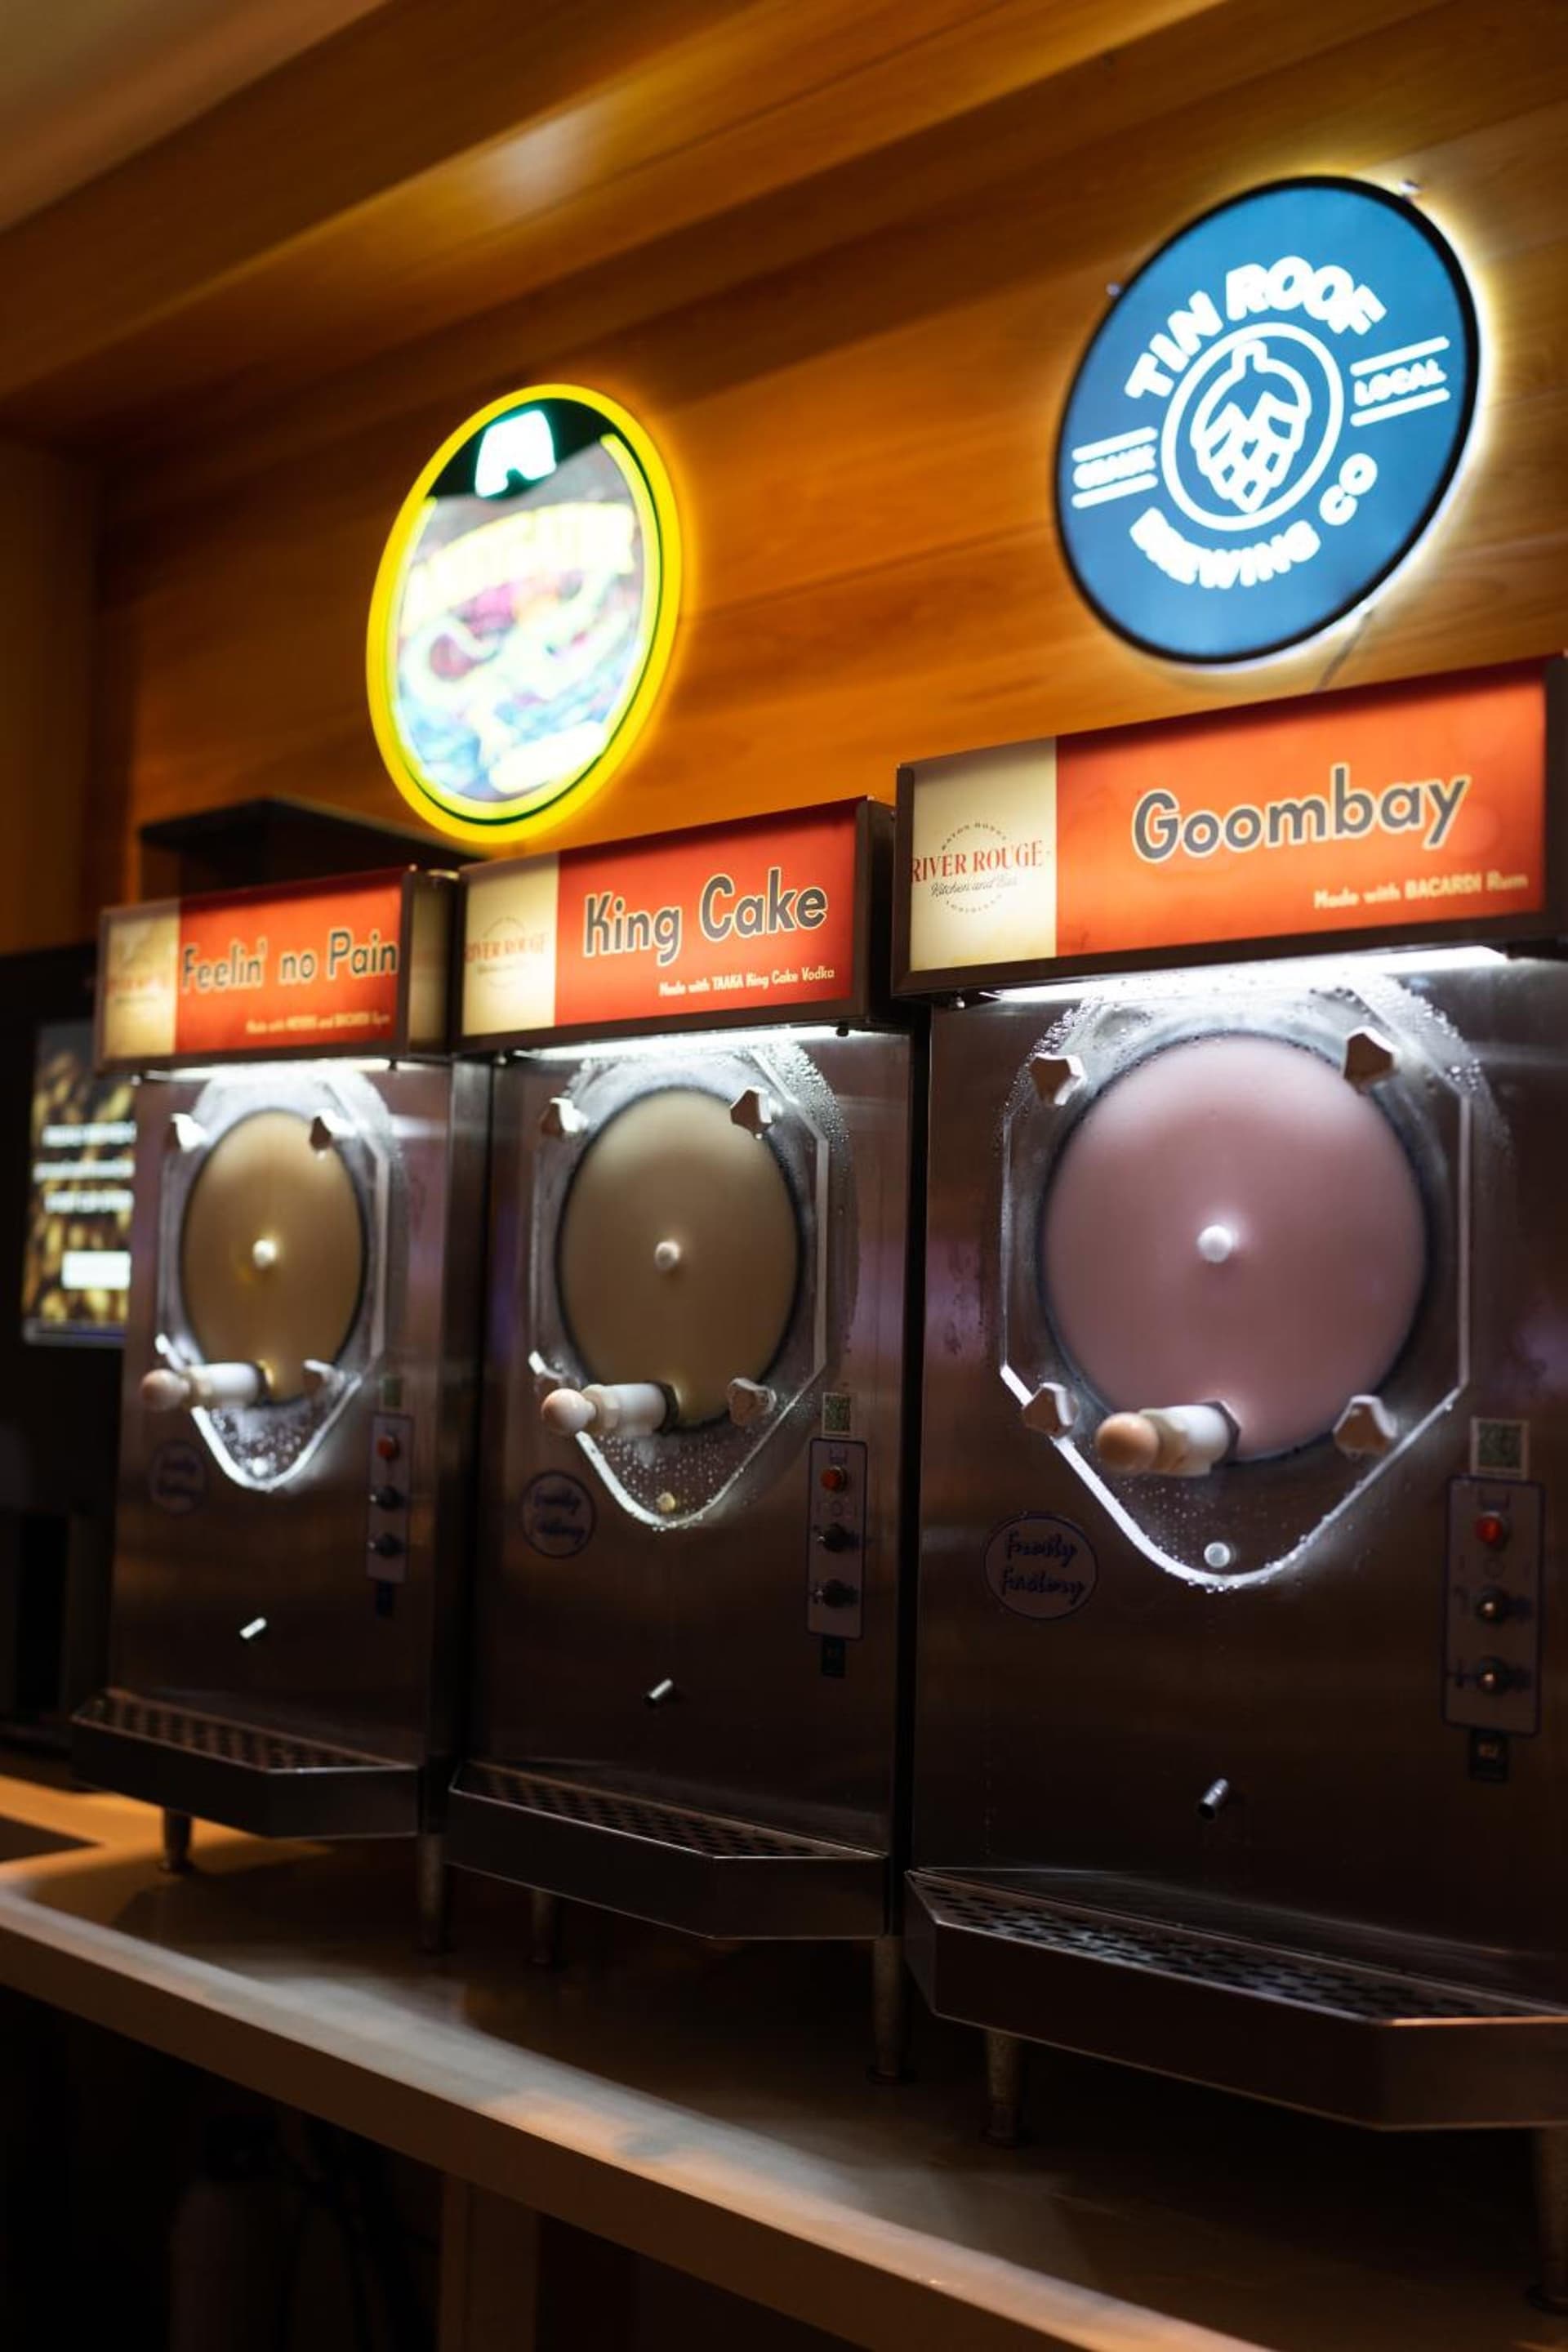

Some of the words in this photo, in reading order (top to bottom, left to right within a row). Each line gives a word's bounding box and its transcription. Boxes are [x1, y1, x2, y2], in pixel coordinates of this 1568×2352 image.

[1125, 291, 1223, 399] TIN
[1226, 256, 1388, 336] ROOF
[1354, 358, 1447, 407] LOCAL
[1319, 453, 1379, 526] CO
[1133, 762, 1472, 864] Goombay
[912, 853, 967, 883] RIVER
[973, 840, 1044, 872] ROUGE
[1404, 871, 1482, 900] BACARDI
[582, 891, 682, 967] King
[699, 866, 829, 942] Cake
[182, 936, 268, 996] Feelin'
[278, 948, 316, 989] no
[327, 928, 399, 980] Pain
[746, 972, 769, 990] King
[772, 968, 799, 985] Cake
[801, 964, 835, 981] Vodka
